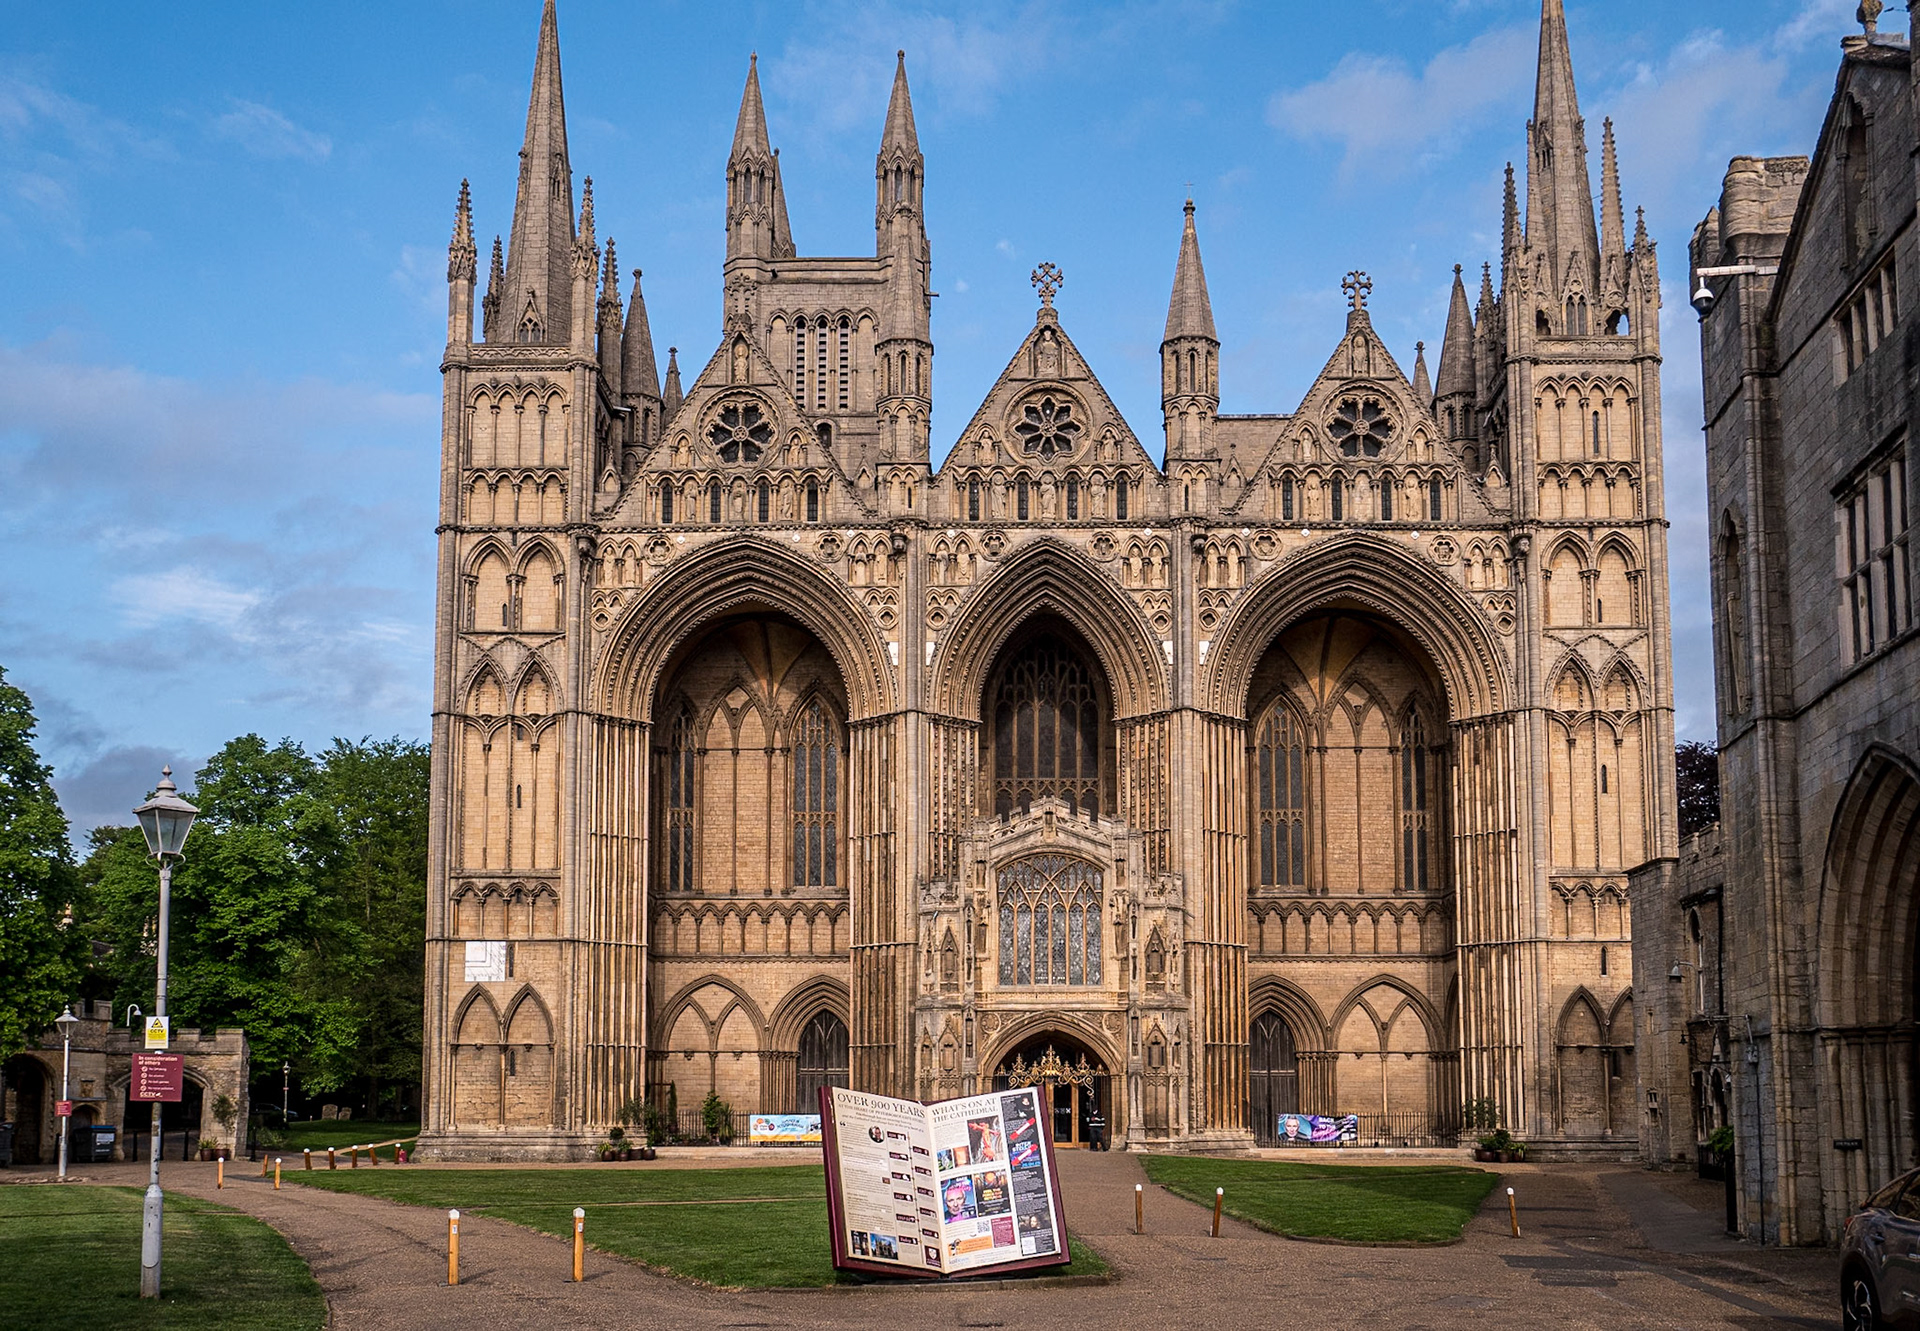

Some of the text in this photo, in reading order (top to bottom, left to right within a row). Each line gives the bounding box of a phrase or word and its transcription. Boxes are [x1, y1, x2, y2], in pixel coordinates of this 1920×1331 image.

[837, 1093, 869, 1106] OVER
[871, 1100, 890, 1111] 900
[892, 1103, 926, 1118] YEARS
[932, 1098, 997, 1115] WHAT'S ON AT
[933, 1114, 950, 1123] THE
[950, 1106, 999, 1119] CATHEDRAL
